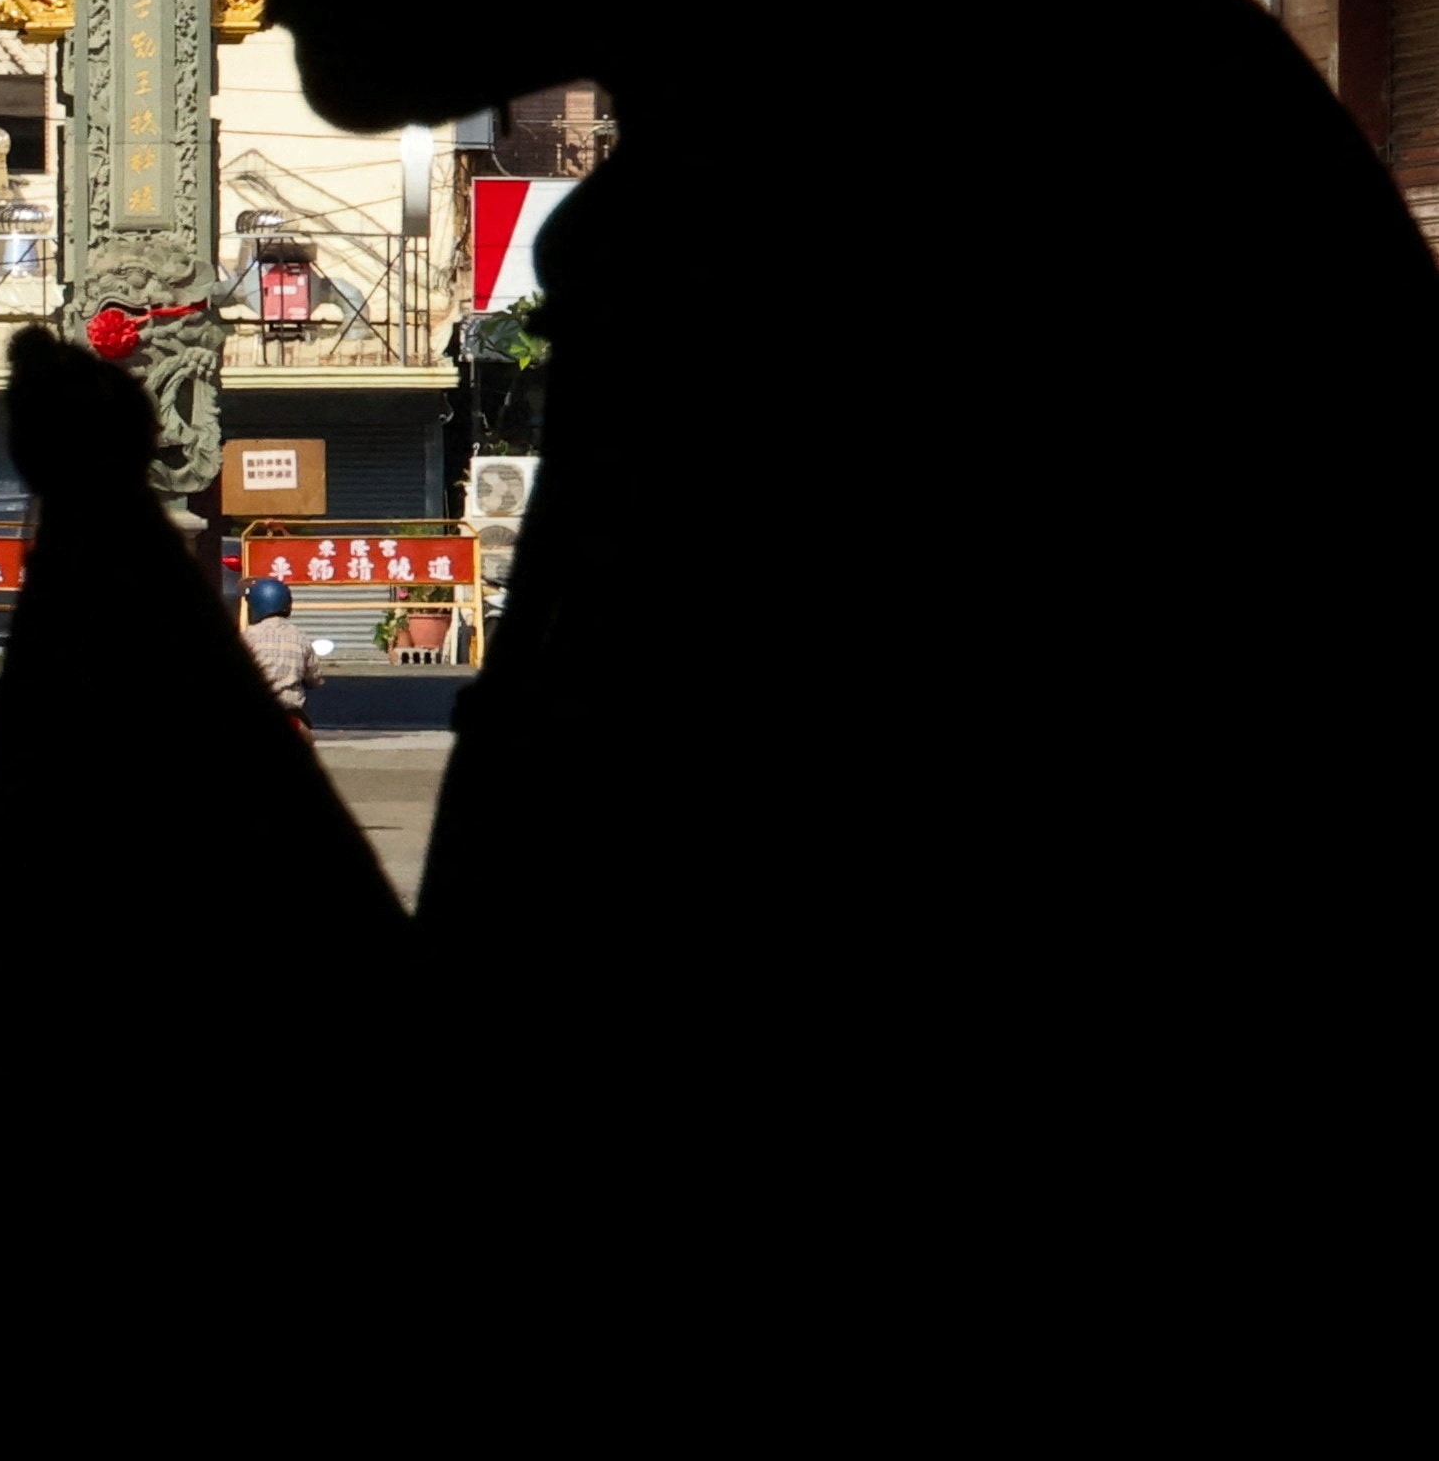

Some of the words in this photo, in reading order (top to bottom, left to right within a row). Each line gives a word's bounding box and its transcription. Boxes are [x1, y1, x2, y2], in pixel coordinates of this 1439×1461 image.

[318, 539, 399, 557] 東隆宮
[268, 556, 455, 581] 車輛請繞道
